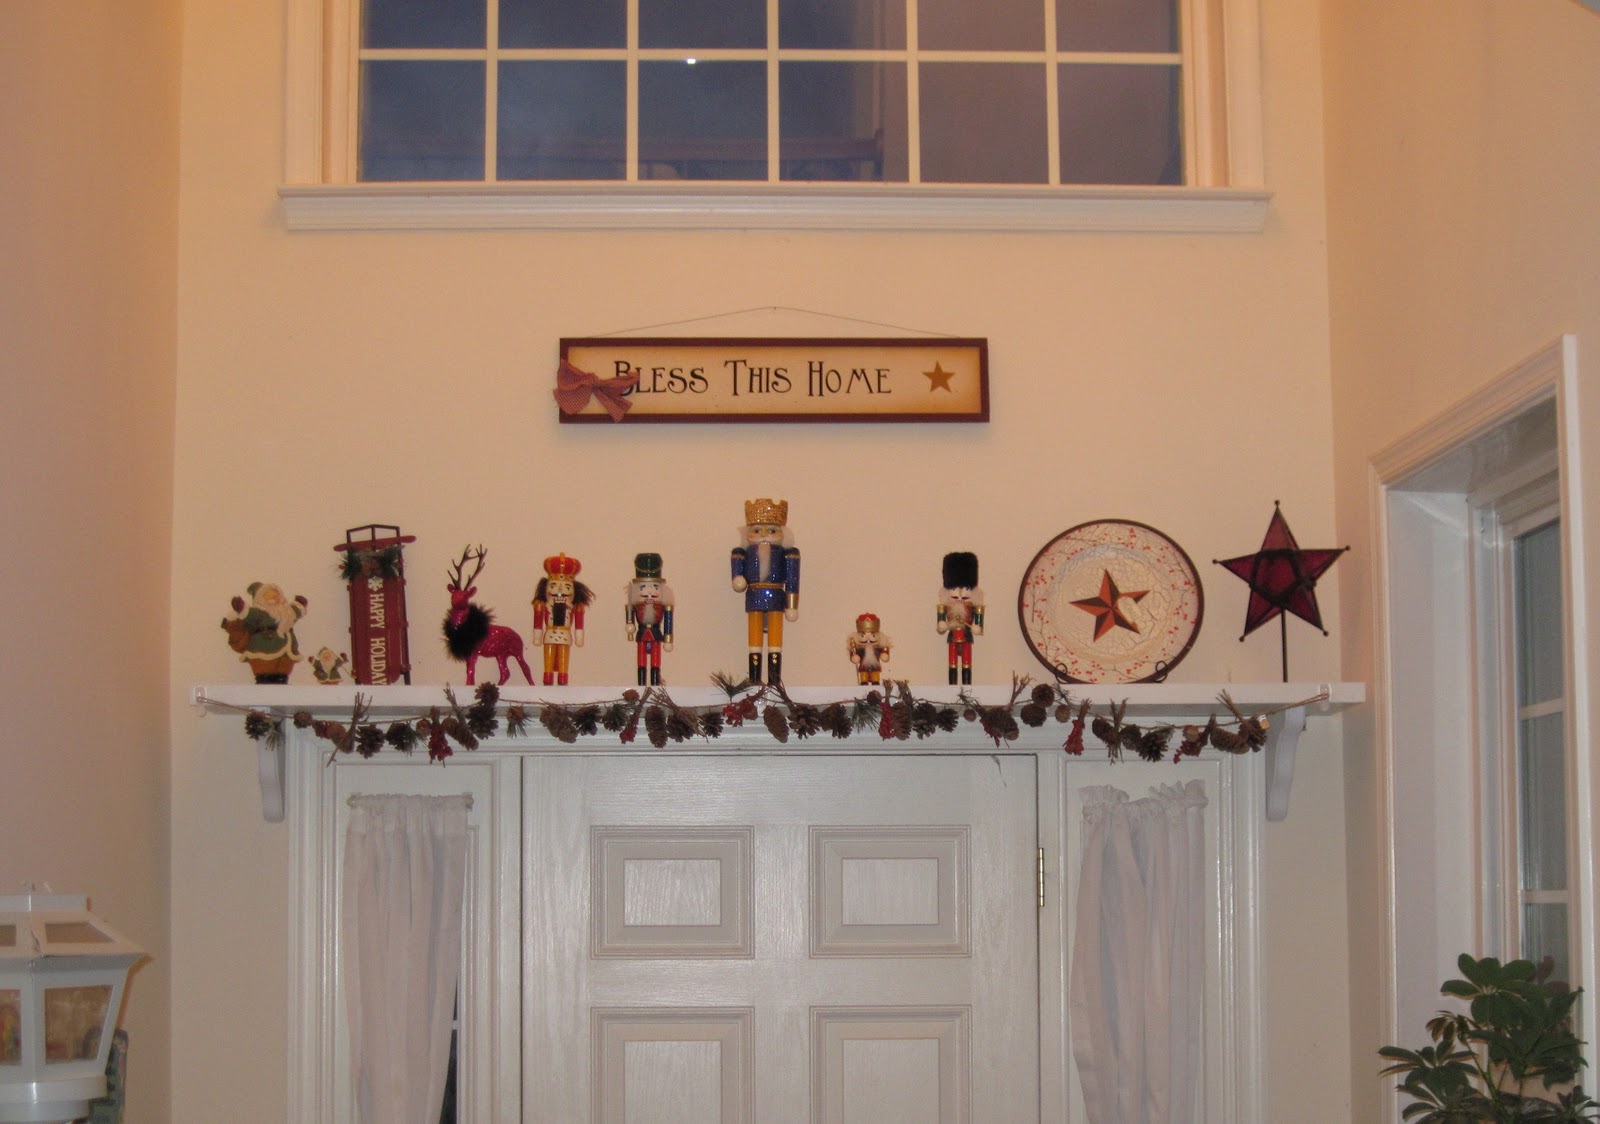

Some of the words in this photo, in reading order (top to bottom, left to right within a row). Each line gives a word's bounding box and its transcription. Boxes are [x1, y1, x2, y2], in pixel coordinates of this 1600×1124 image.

[613, 360, 709, 397] BLESS
[723, 359, 792, 396] THIS
[807, 360, 892, 397] HOME
[369, 593, 385, 629] HAPPY
